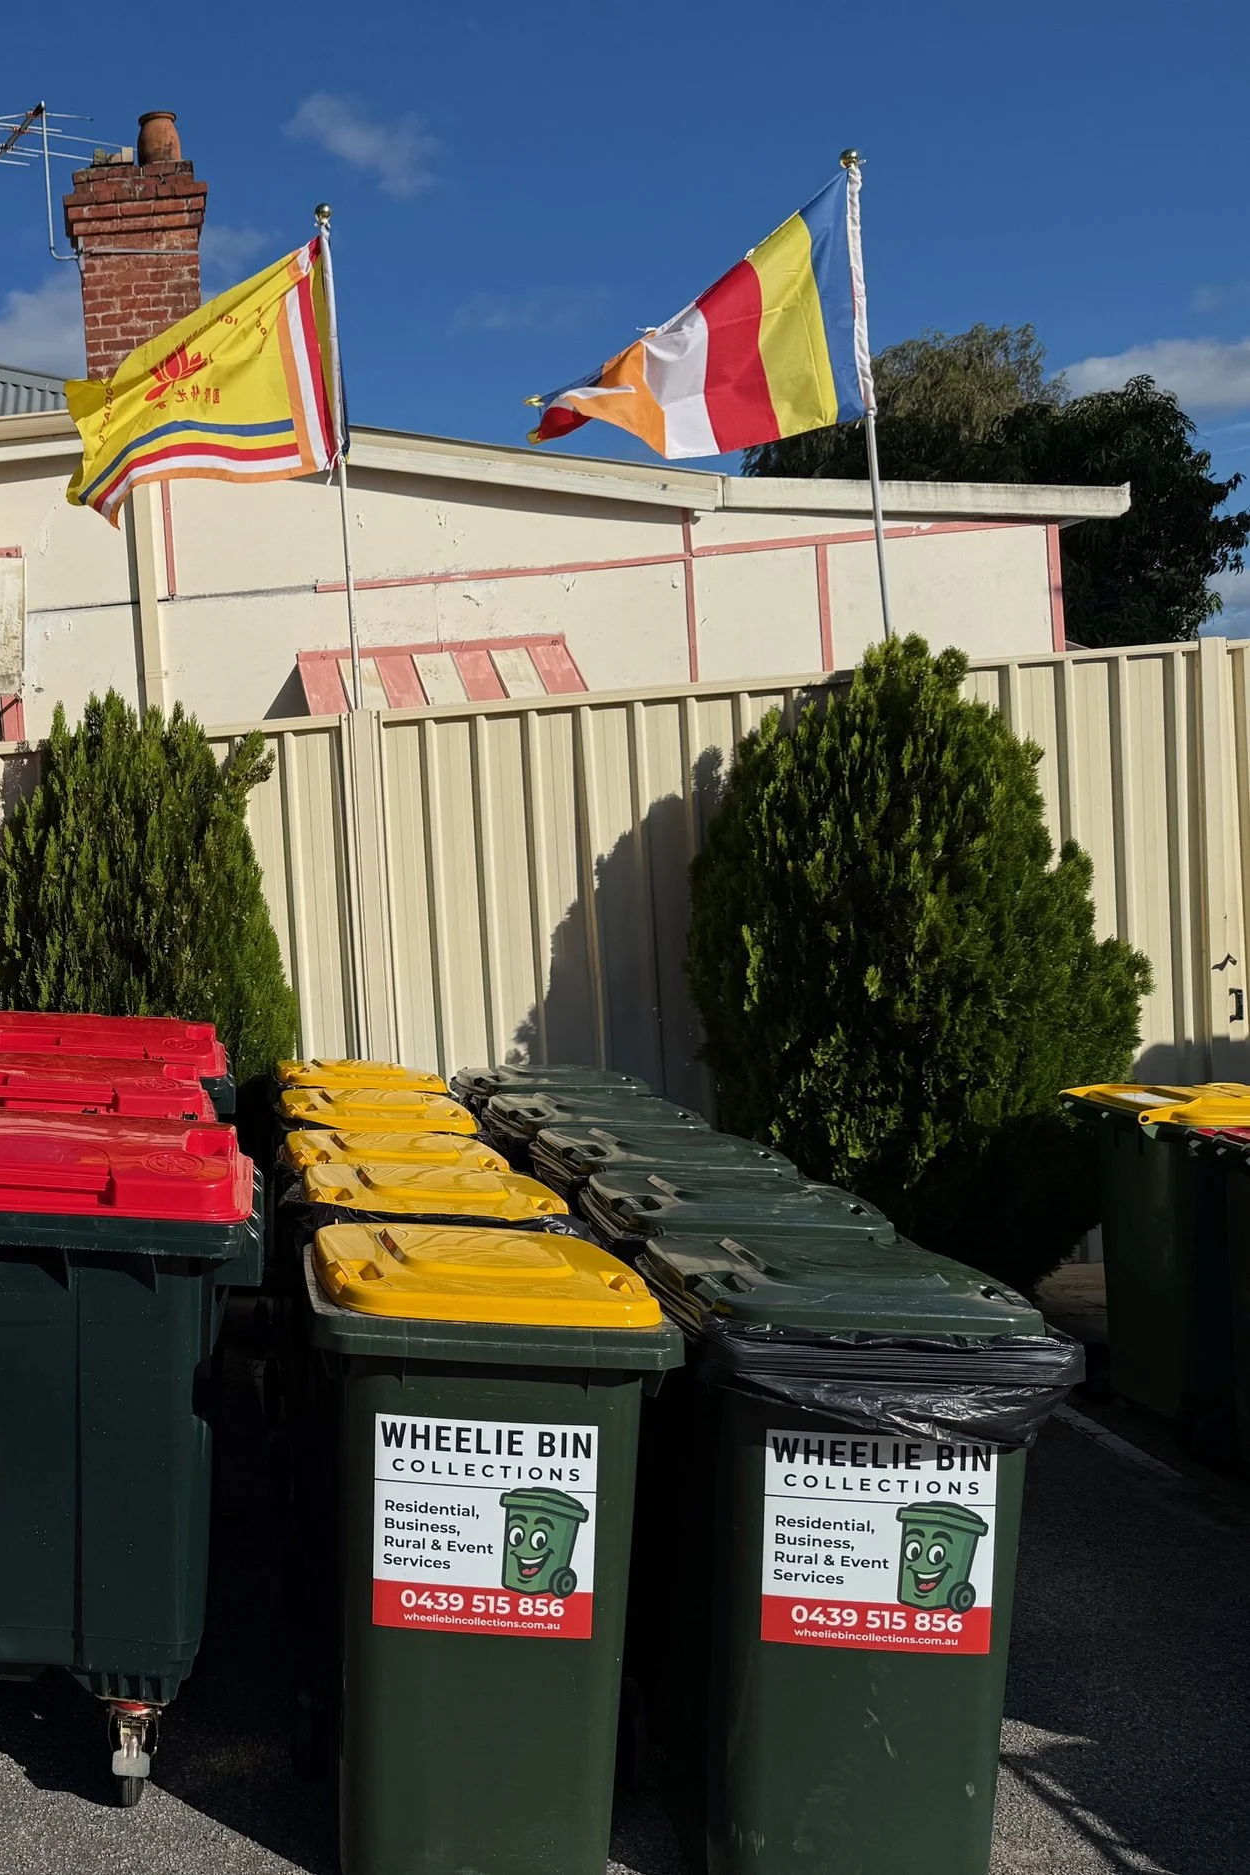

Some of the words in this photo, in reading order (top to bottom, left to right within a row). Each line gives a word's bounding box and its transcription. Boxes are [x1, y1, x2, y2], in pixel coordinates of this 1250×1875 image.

[381, 1421, 523, 1456] WHEELIE
[538, 1431, 591, 1459] BIN
[772, 1437, 921, 1470] WHEELIE
[936, 1444, 990, 1472] BIN
[393, 1458, 579, 1482] COLLECTIONS
[784, 1474, 979, 1495] COLLECTIONS
[385, 1499, 479, 1519] Residential,
[384, 1517, 460, 1536] Business,
[775, 1515, 874, 1534] Residential,
[384, 1536, 425, 1549] Rural
[431, 1539, 441, 1550] &
[448, 1541, 493, 1554] Event
[775, 1533, 854, 1551] Business,
[383, 1553, 450, 1570] Services
[775, 1551, 818, 1565] Rural
[824, 1555, 835, 1566] &
[841, 1556, 889, 1569] Event
[773, 1569, 844, 1584] Services
[401, 1589, 464, 1611] 0439
[471, 1594, 510, 1614] 515
[518, 1598, 564, 1617] 856
[404, 1612, 560, 1630] wheeliebincollections.com.au
[791, 1605, 857, 1627] 0439
[866, 1610, 906, 1630] 515
[914, 1613, 962, 1633] 856
[794, 1628, 958, 1646] wheeliebincollections.com.au
